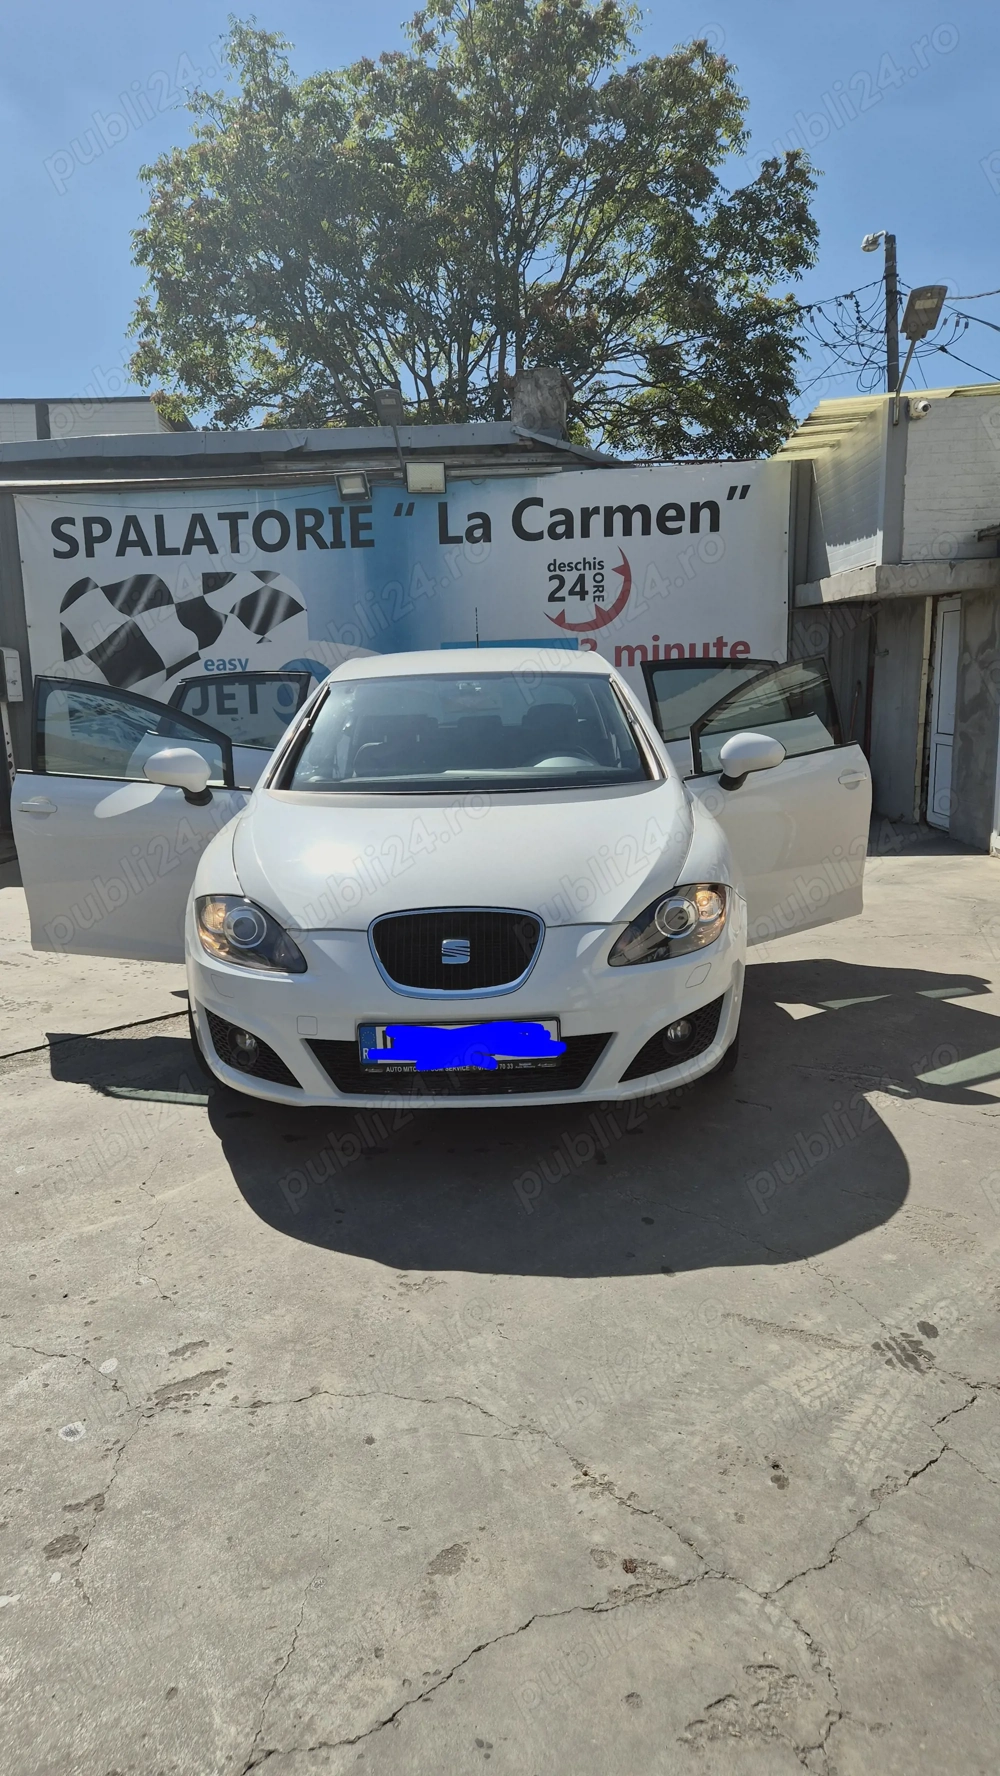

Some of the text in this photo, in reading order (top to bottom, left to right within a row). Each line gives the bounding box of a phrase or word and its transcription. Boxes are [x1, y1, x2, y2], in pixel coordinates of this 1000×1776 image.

[51, 505, 375, 559] SPALATORIE
[438, 501, 492, 545] La
[547, 556, 605, 572] deschis
[547, 573, 589, 602] 24
[592, 572, 605, 602] ORE
[204, 658, 249, 672] easy
[614, 634, 751, 667] minute
[191, 682, 266, 717] JET
